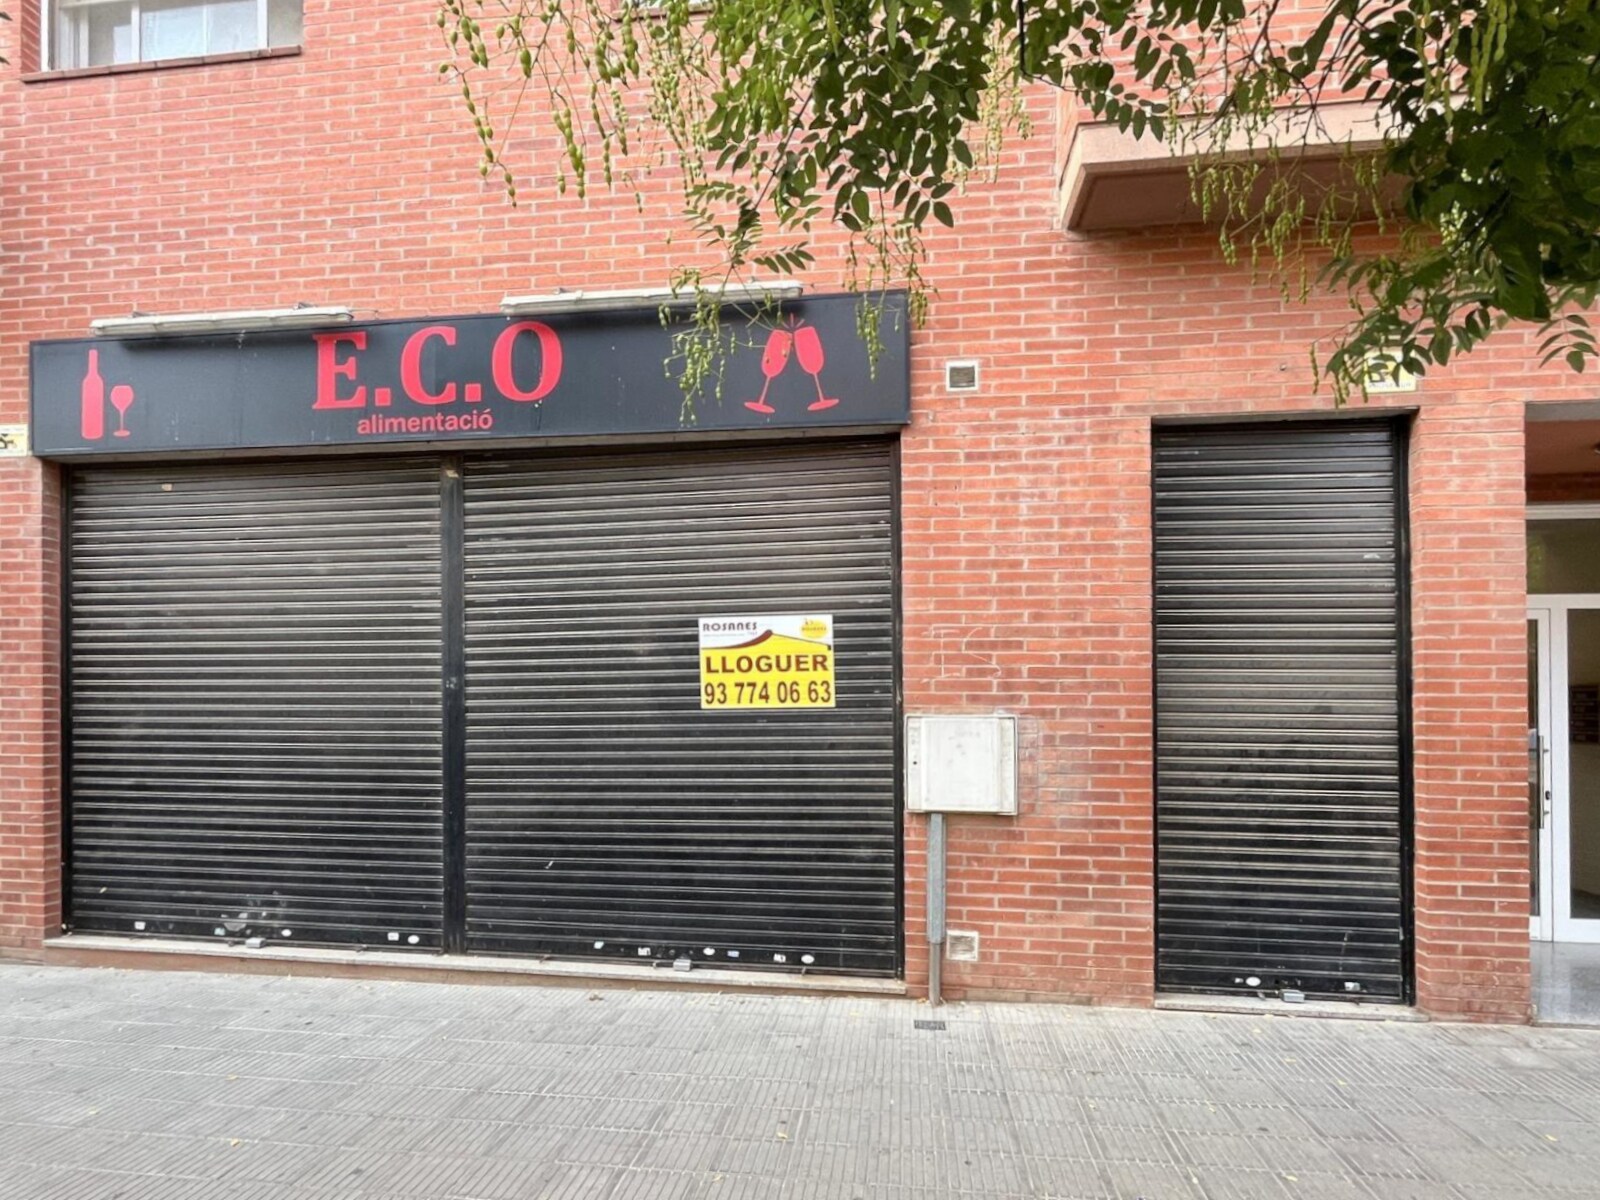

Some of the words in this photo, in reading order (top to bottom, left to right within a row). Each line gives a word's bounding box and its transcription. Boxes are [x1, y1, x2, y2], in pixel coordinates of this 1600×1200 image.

[312, 321, 563, 409] E.C.O
[357, 409, 493, 434] alimentació
[703, 622, 757, 632] ROSANES
[706, 655, 829, 673] LLOGUER
[704, 682, 727, 704] 93
[735, 682, 770, 703] 774
[777, 681, 800, 703] 06
[808, 680, 831, 703] 63
